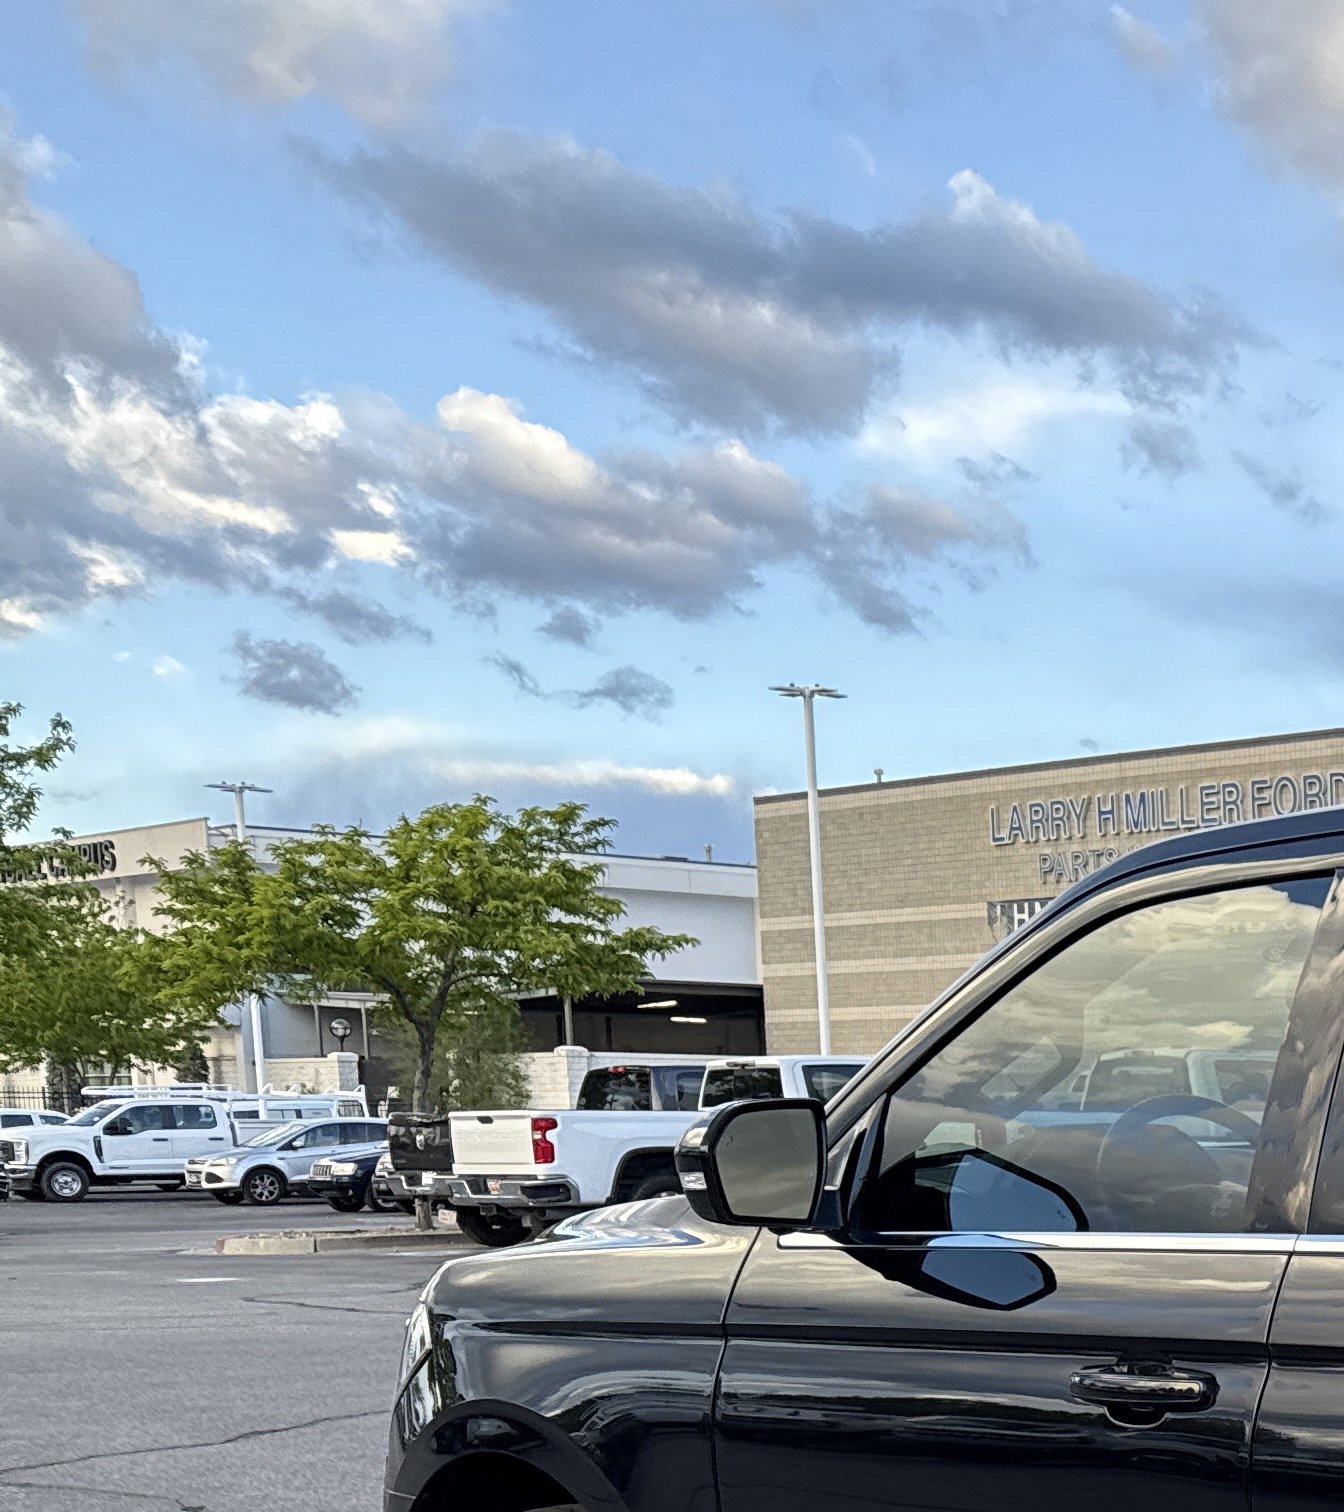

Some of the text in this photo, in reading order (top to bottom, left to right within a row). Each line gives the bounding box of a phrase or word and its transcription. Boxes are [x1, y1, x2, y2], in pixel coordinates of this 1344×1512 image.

[989, 795, 1088, 846] LARRY
[1096, 793, 1118, 836] H
[1123, 780, 1244, 832] MILLER
